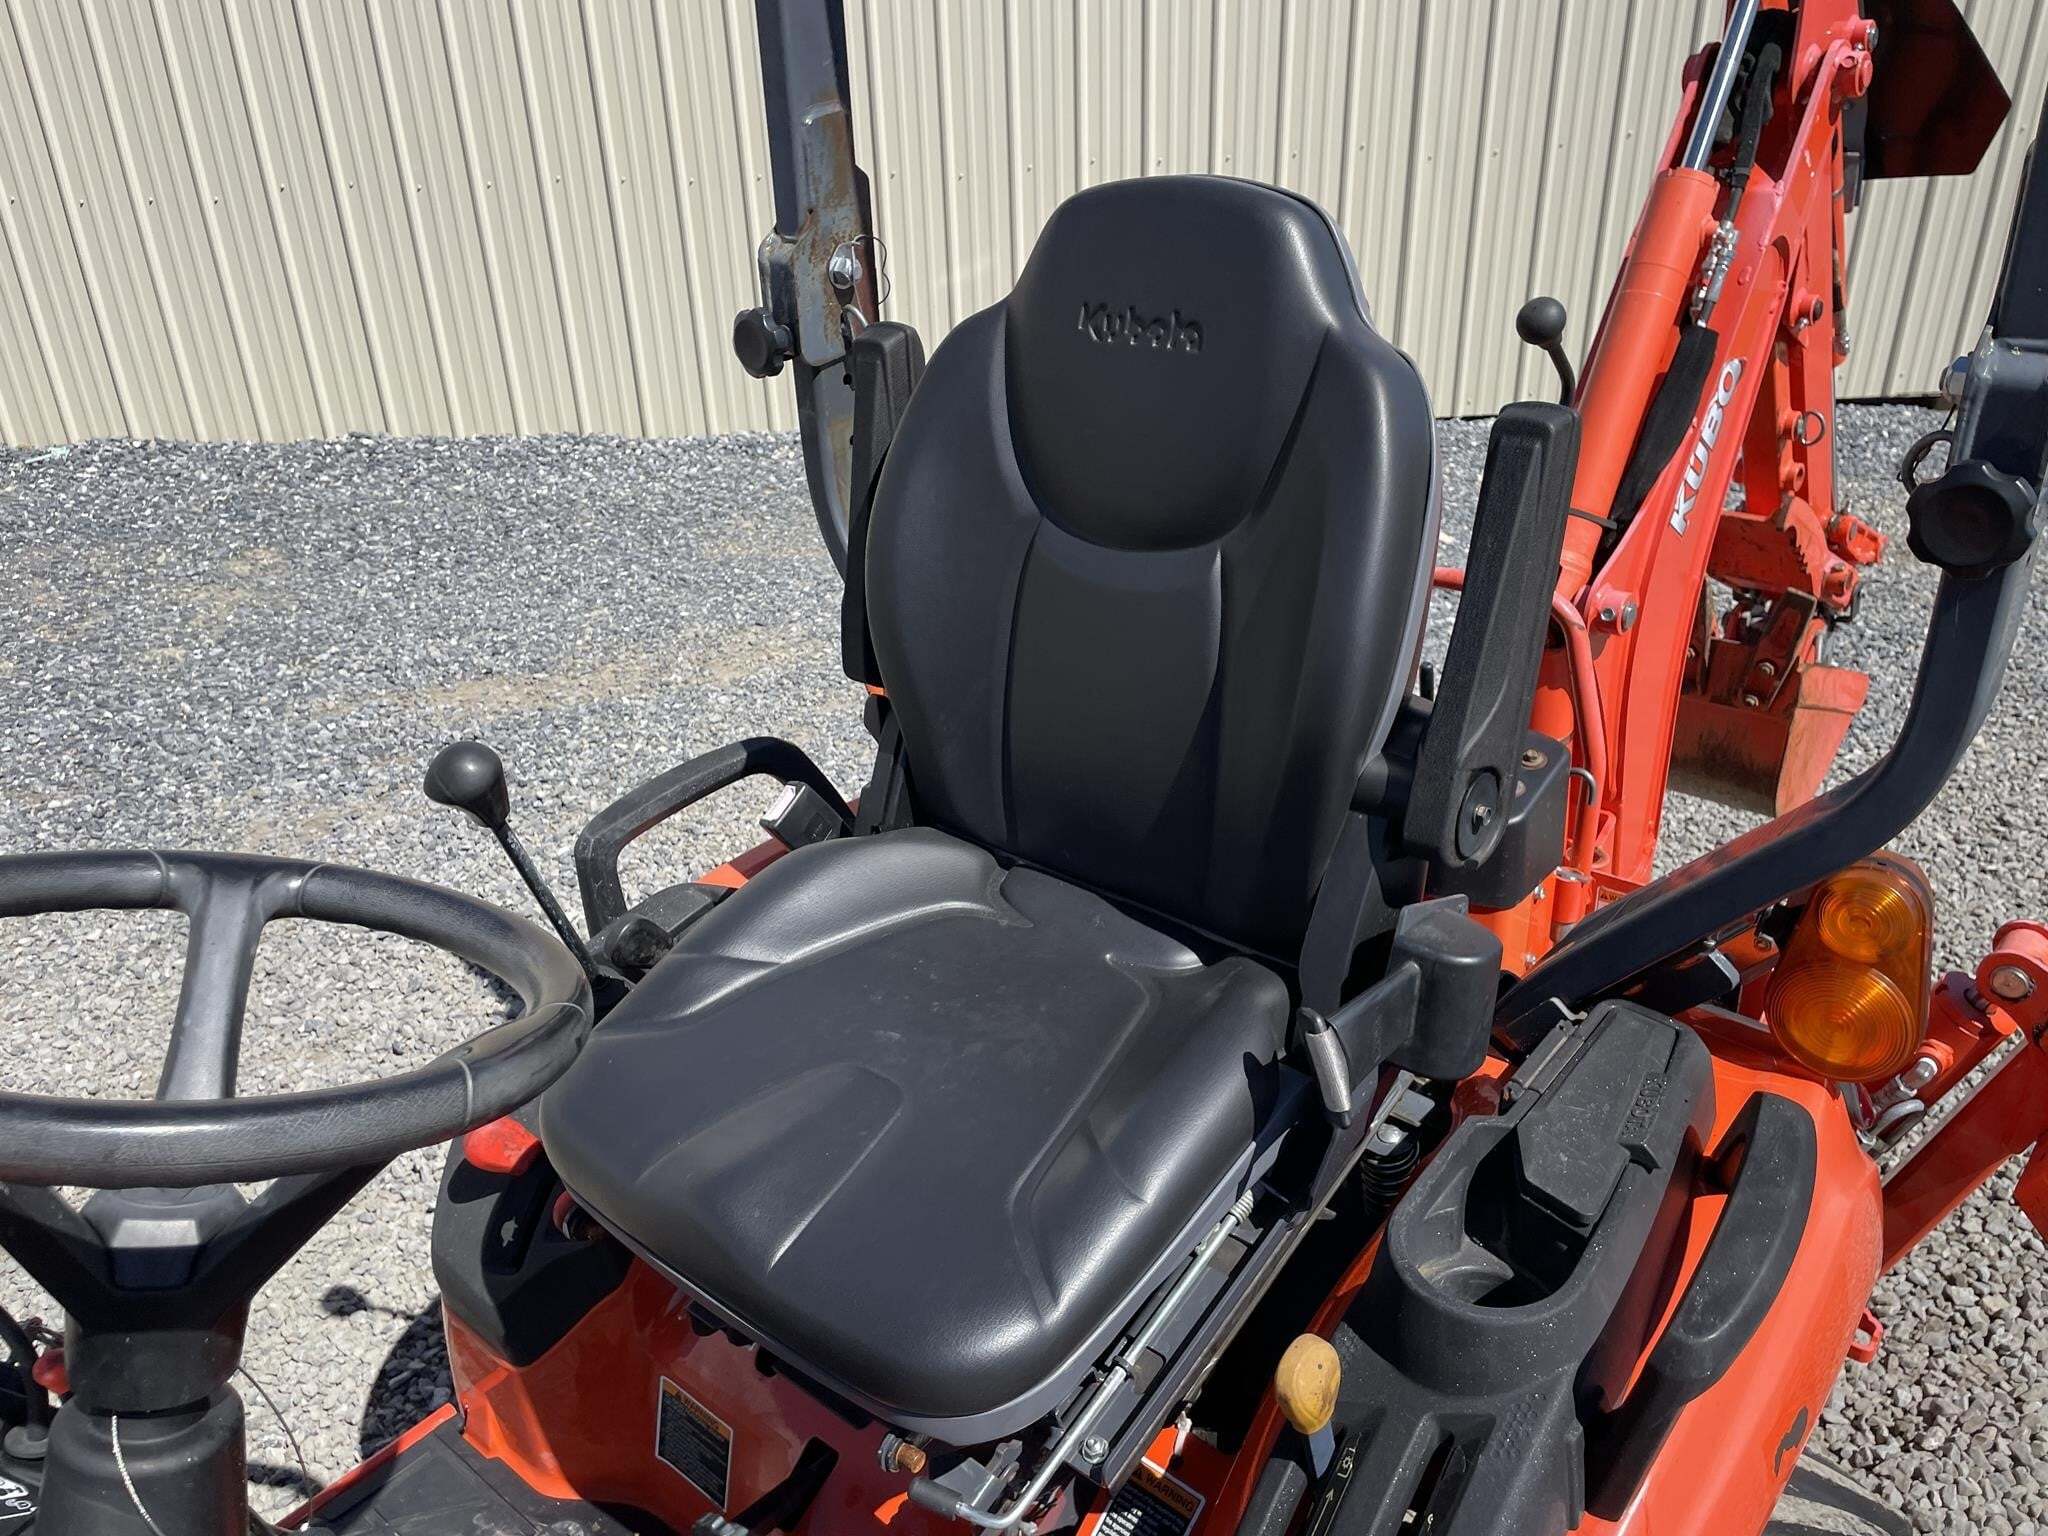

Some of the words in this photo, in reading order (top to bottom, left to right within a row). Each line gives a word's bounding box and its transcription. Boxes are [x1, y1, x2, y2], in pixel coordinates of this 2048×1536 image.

[1077, 302, 1202, 352] Kubota
[1669, 358, 1744, 537] KUBO
[1145, 1473, 1193, 1513] WARNING
